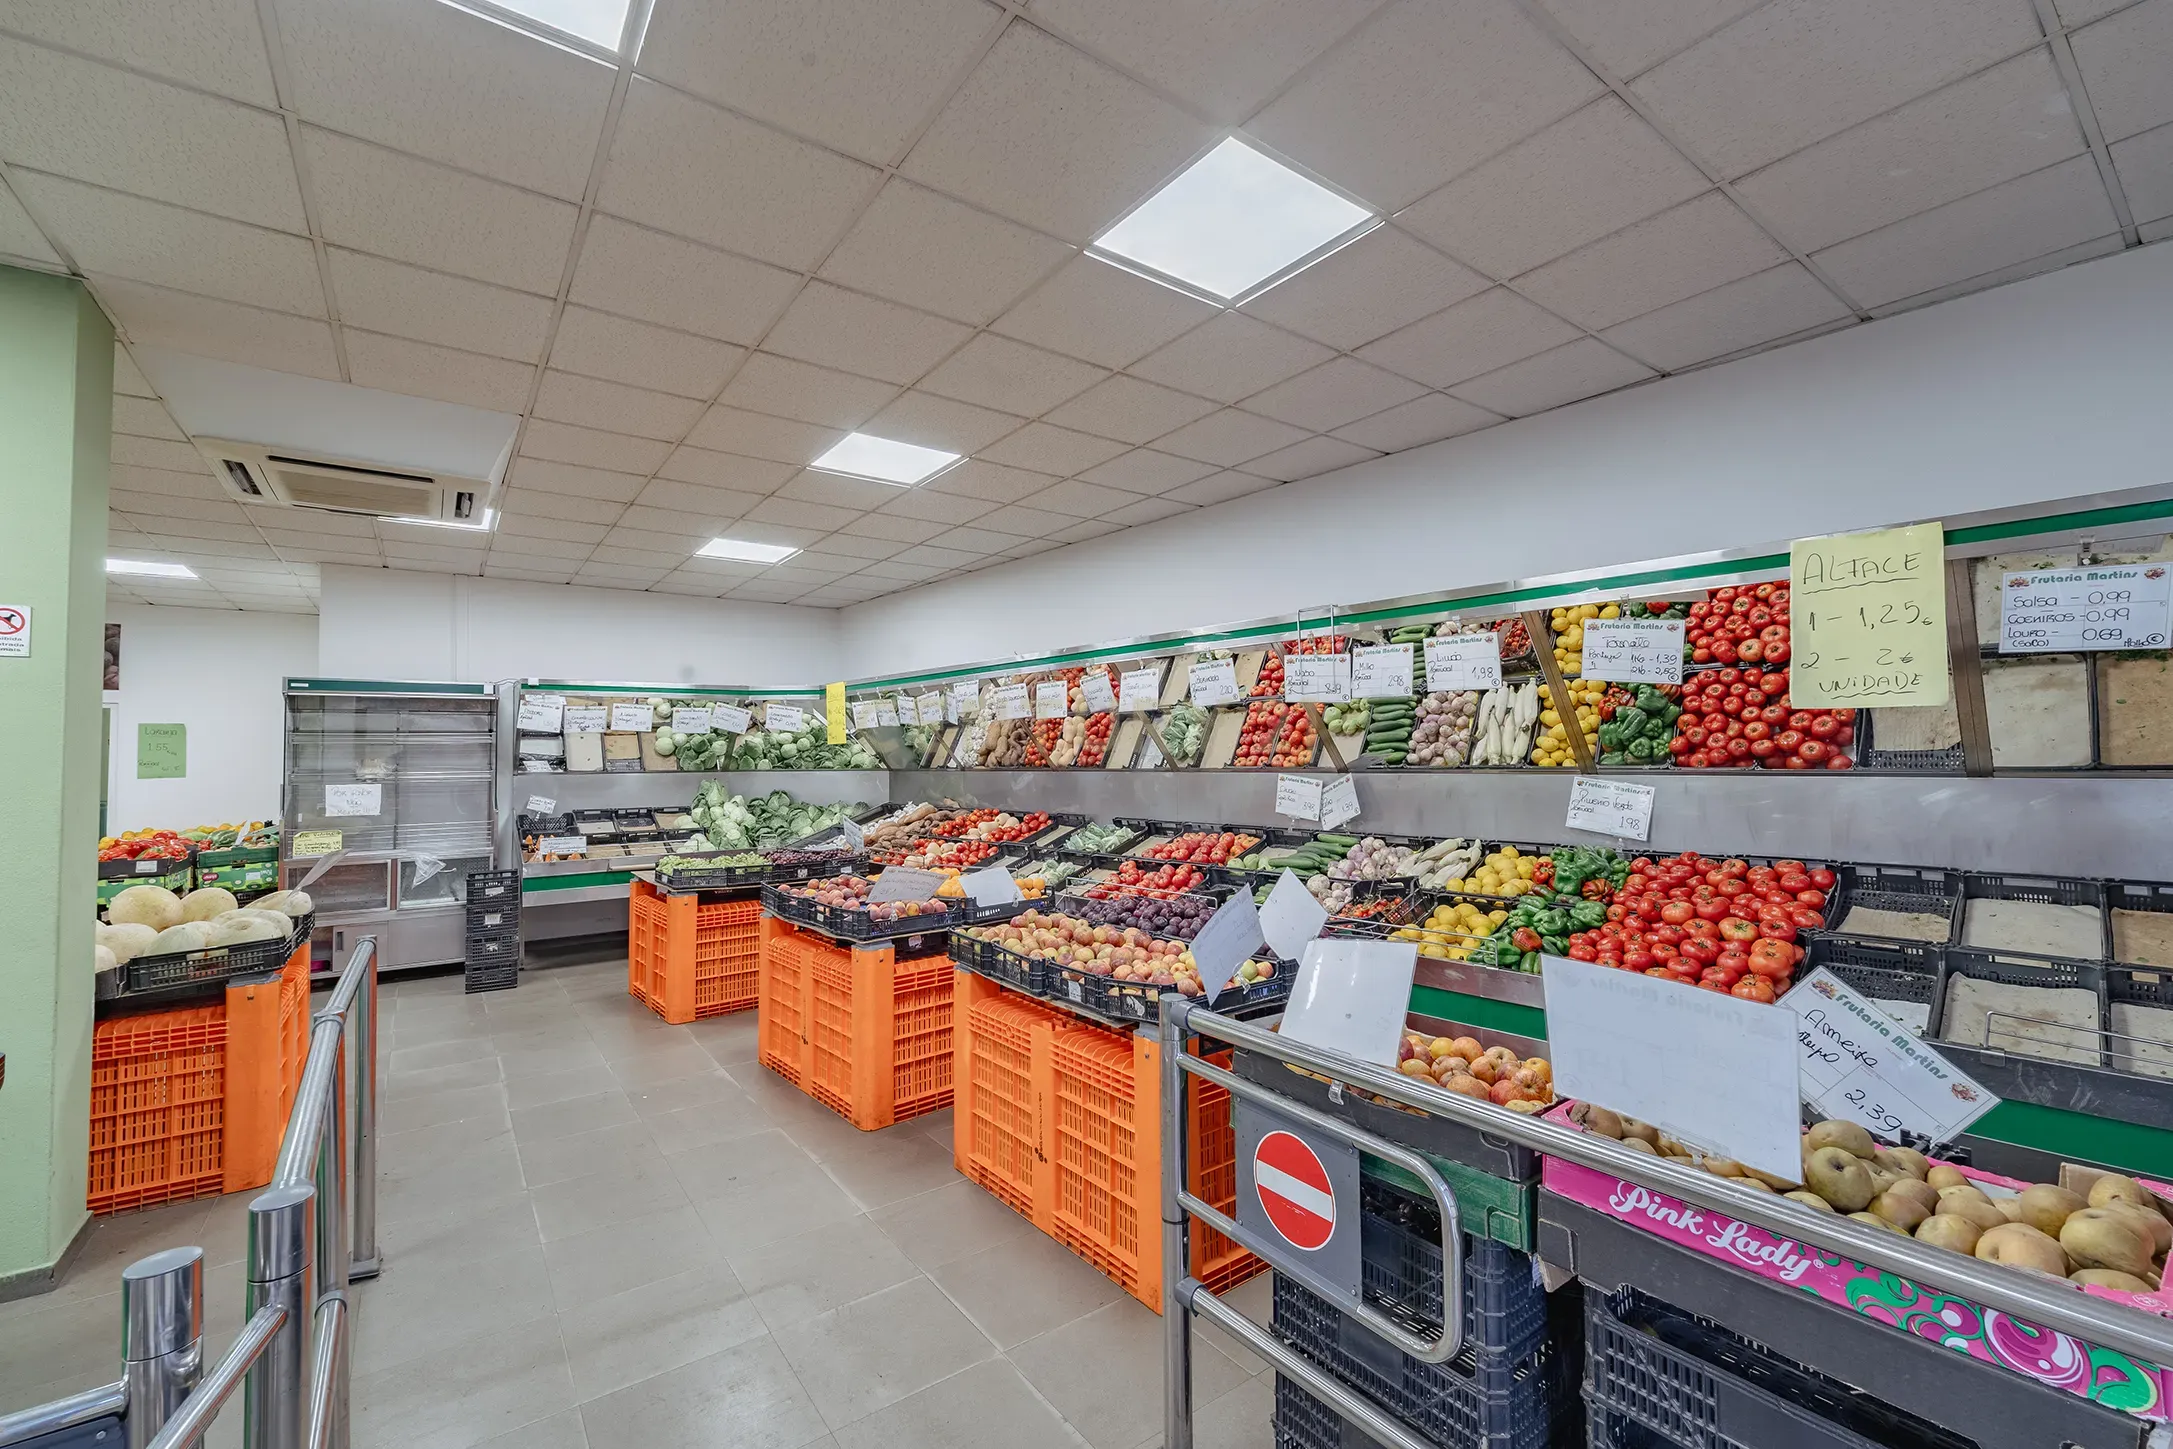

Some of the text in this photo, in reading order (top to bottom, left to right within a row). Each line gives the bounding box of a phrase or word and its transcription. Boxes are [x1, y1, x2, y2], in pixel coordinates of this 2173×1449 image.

[2030, 573, 2082, 585] Frutaria
[2087, 570, 2138, 581] Martins
[2013, 595, 2058, 608] Salsa
[2008, 627, 2047, 638] LOURO
[1836, 993, 1891, 1037] Frutaria
[1891, 1035, 1949, 1080] Martins
[1845, 1089, 1903, 1133] 2,39
[1609, 1180, 1812, 1281] Pink Lady
